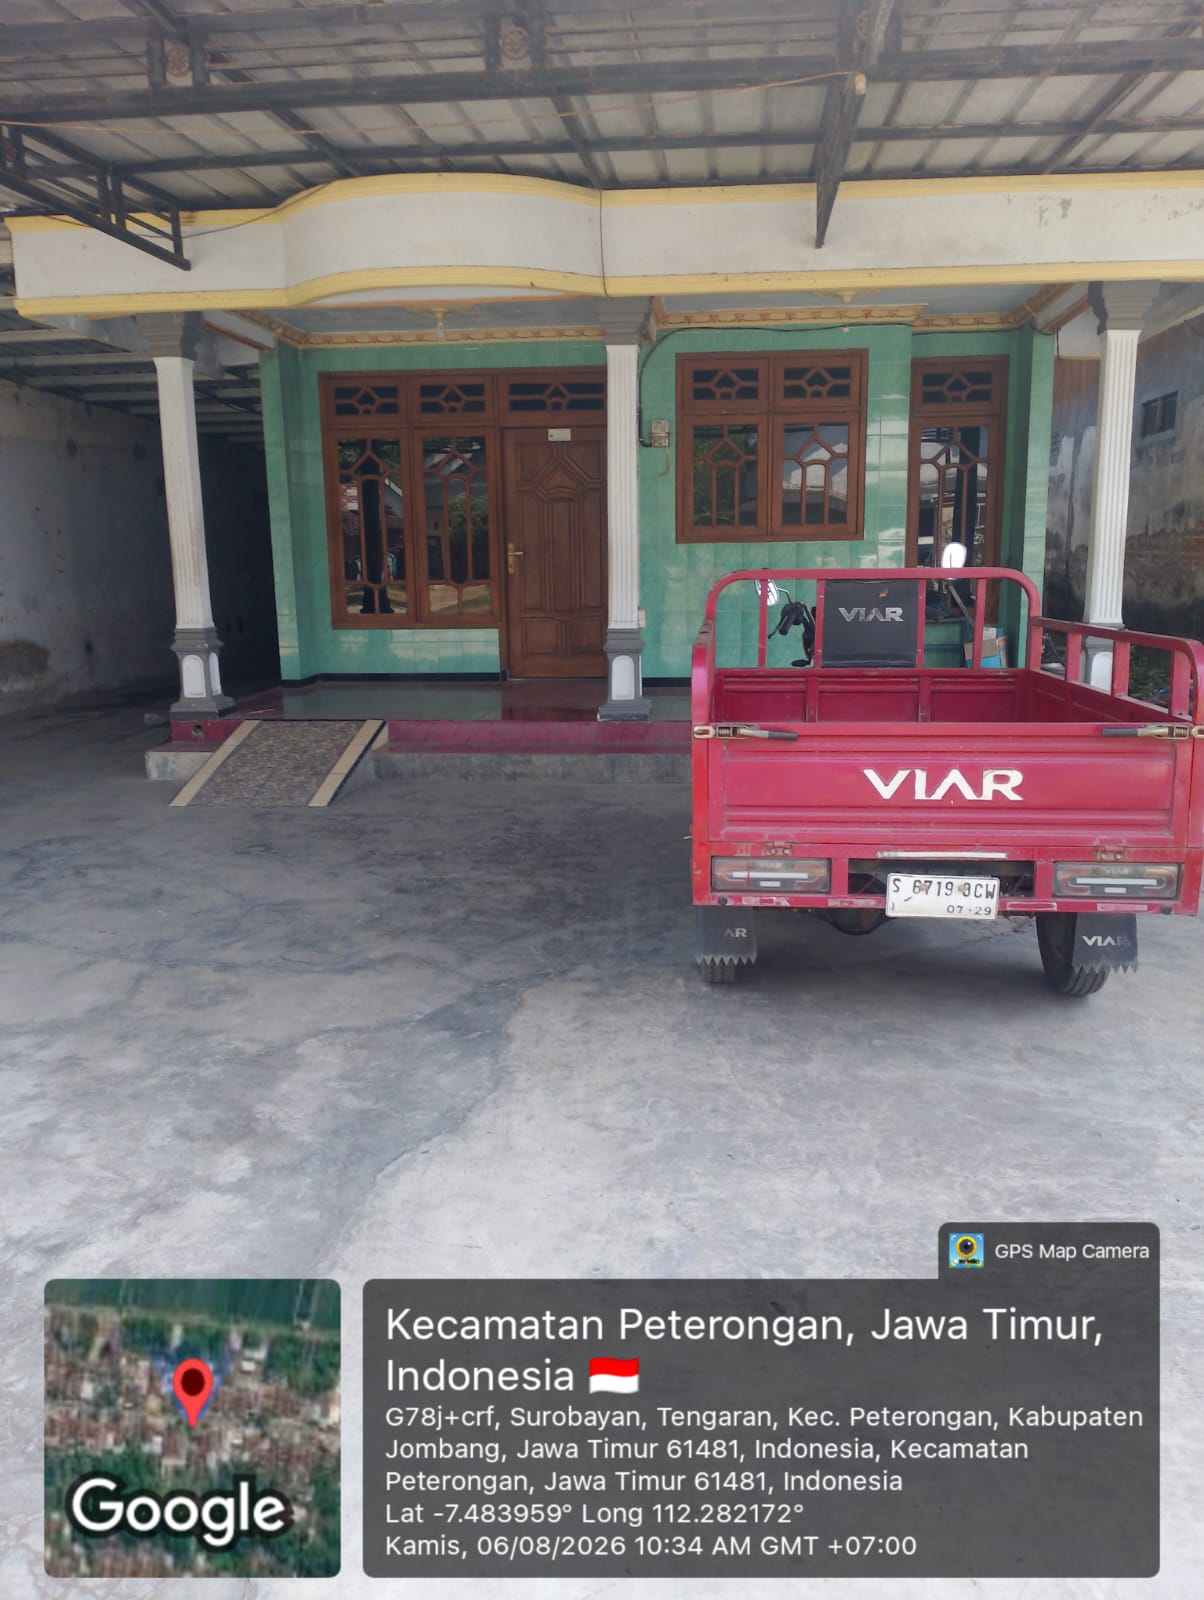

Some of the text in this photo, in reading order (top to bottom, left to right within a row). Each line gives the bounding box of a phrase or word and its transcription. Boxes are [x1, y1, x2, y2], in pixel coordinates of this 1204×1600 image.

[838, 607, 904, 622] VIAR
[863, 768, 1024, 801] VIAR
[892, 877, 902, 894] S
[912, 879, 954, 897] 6719
